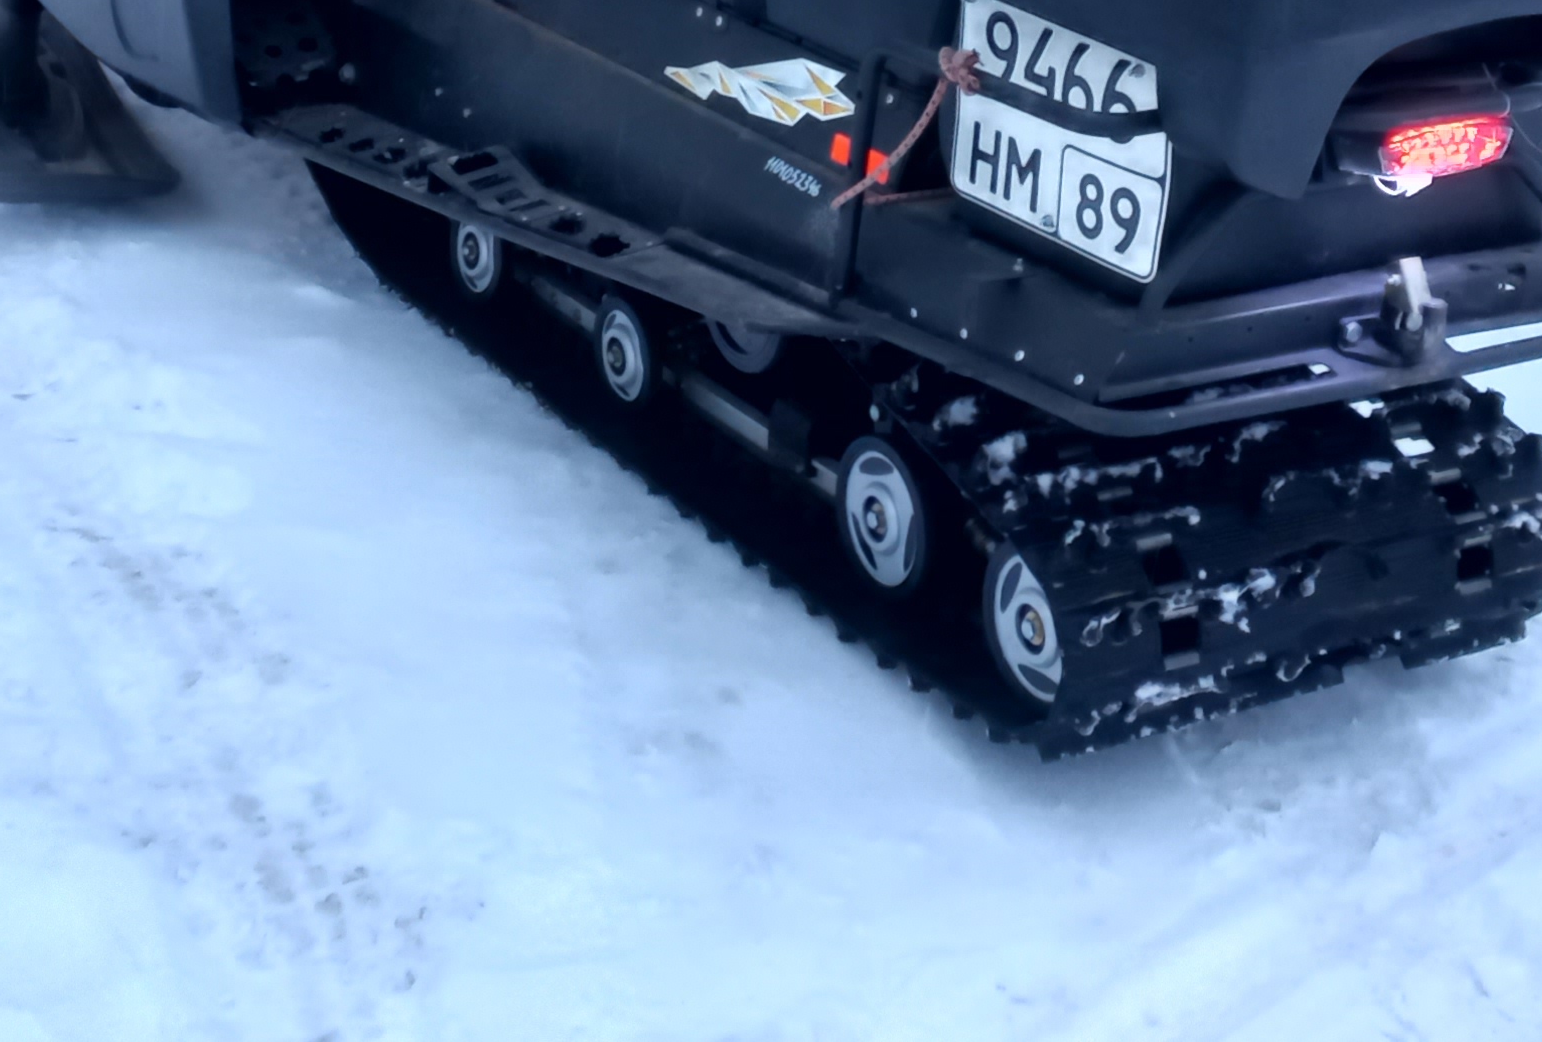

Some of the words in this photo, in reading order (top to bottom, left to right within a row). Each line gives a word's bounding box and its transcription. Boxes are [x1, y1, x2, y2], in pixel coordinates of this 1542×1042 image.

[985, 11, 1137, 113] 9466
[969, 121, 1042, 213] НМ
[1076, 173, 1141, 254] 89
